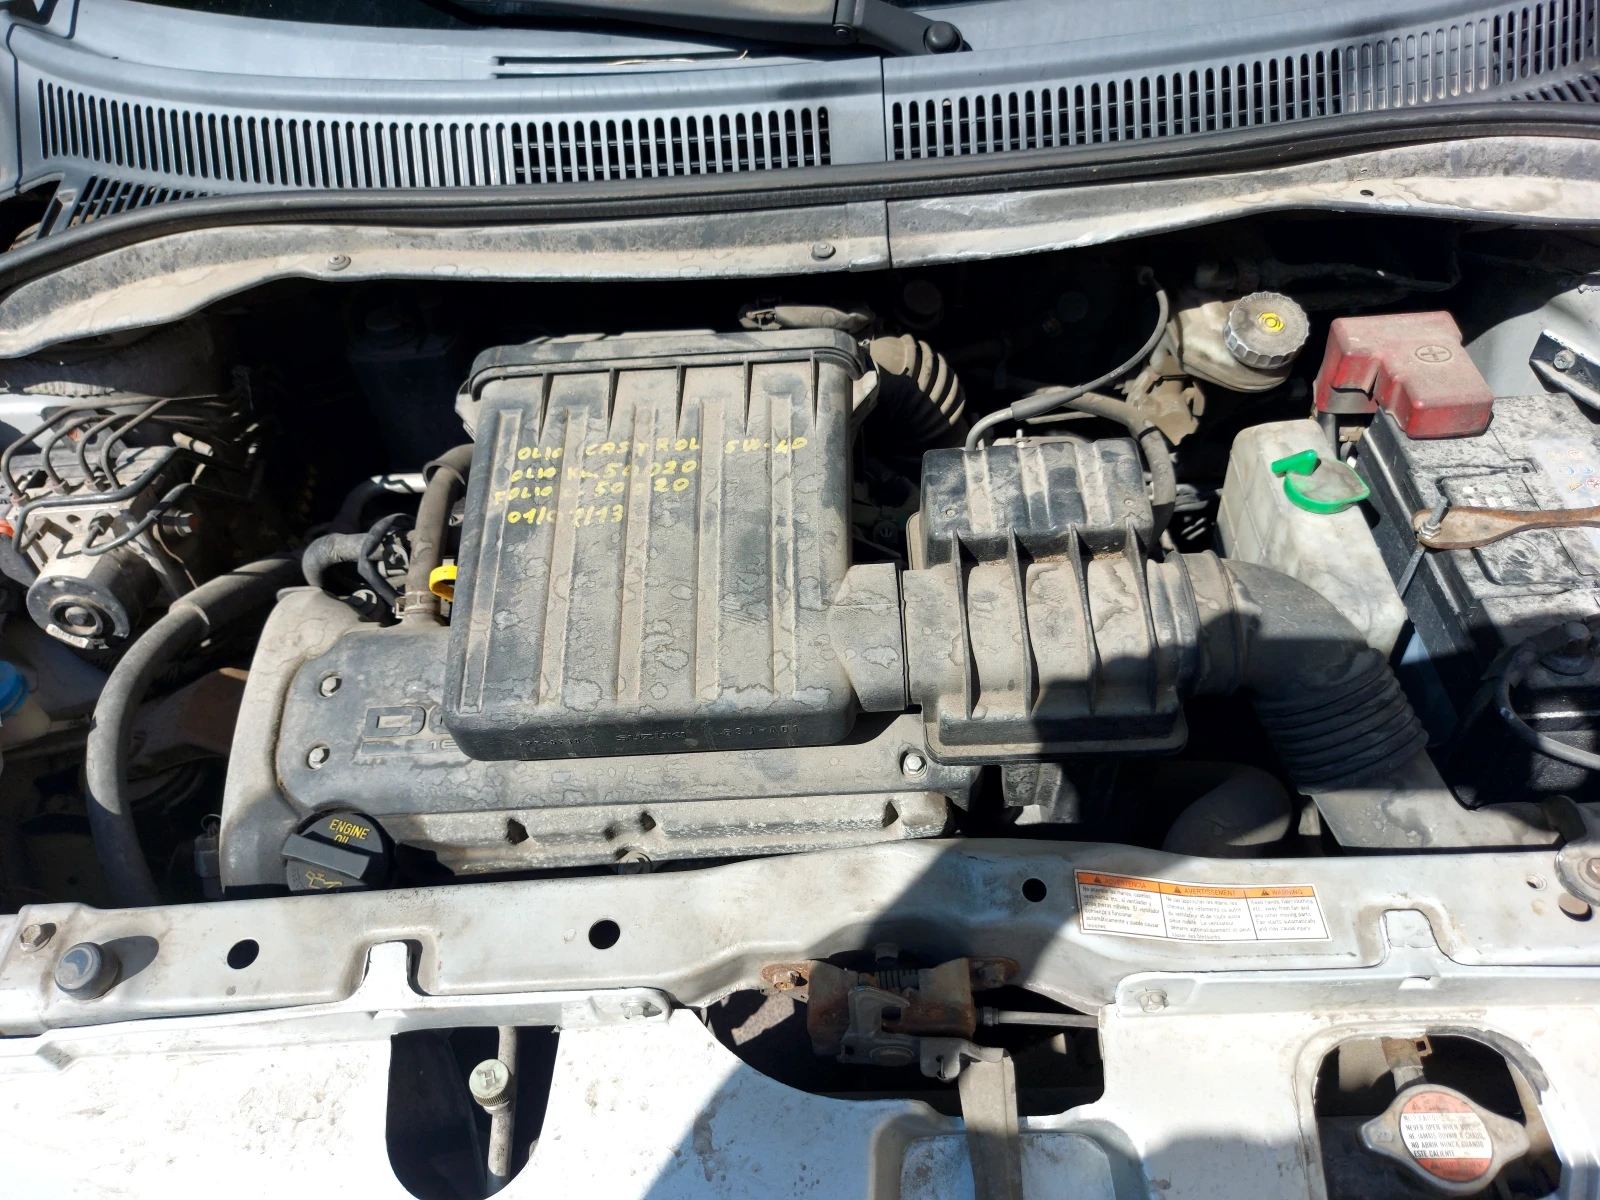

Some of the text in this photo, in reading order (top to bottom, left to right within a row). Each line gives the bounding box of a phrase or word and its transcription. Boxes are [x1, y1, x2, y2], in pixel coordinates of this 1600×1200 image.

[517, 446, 564, 460] OLIO
[585, 437, 700, 457] CASTROL
[510, 466, 556, 482] OLIO
[616, 730, 686, 741] SUZUKI
[329, 818, 371, 840] ENGINE
